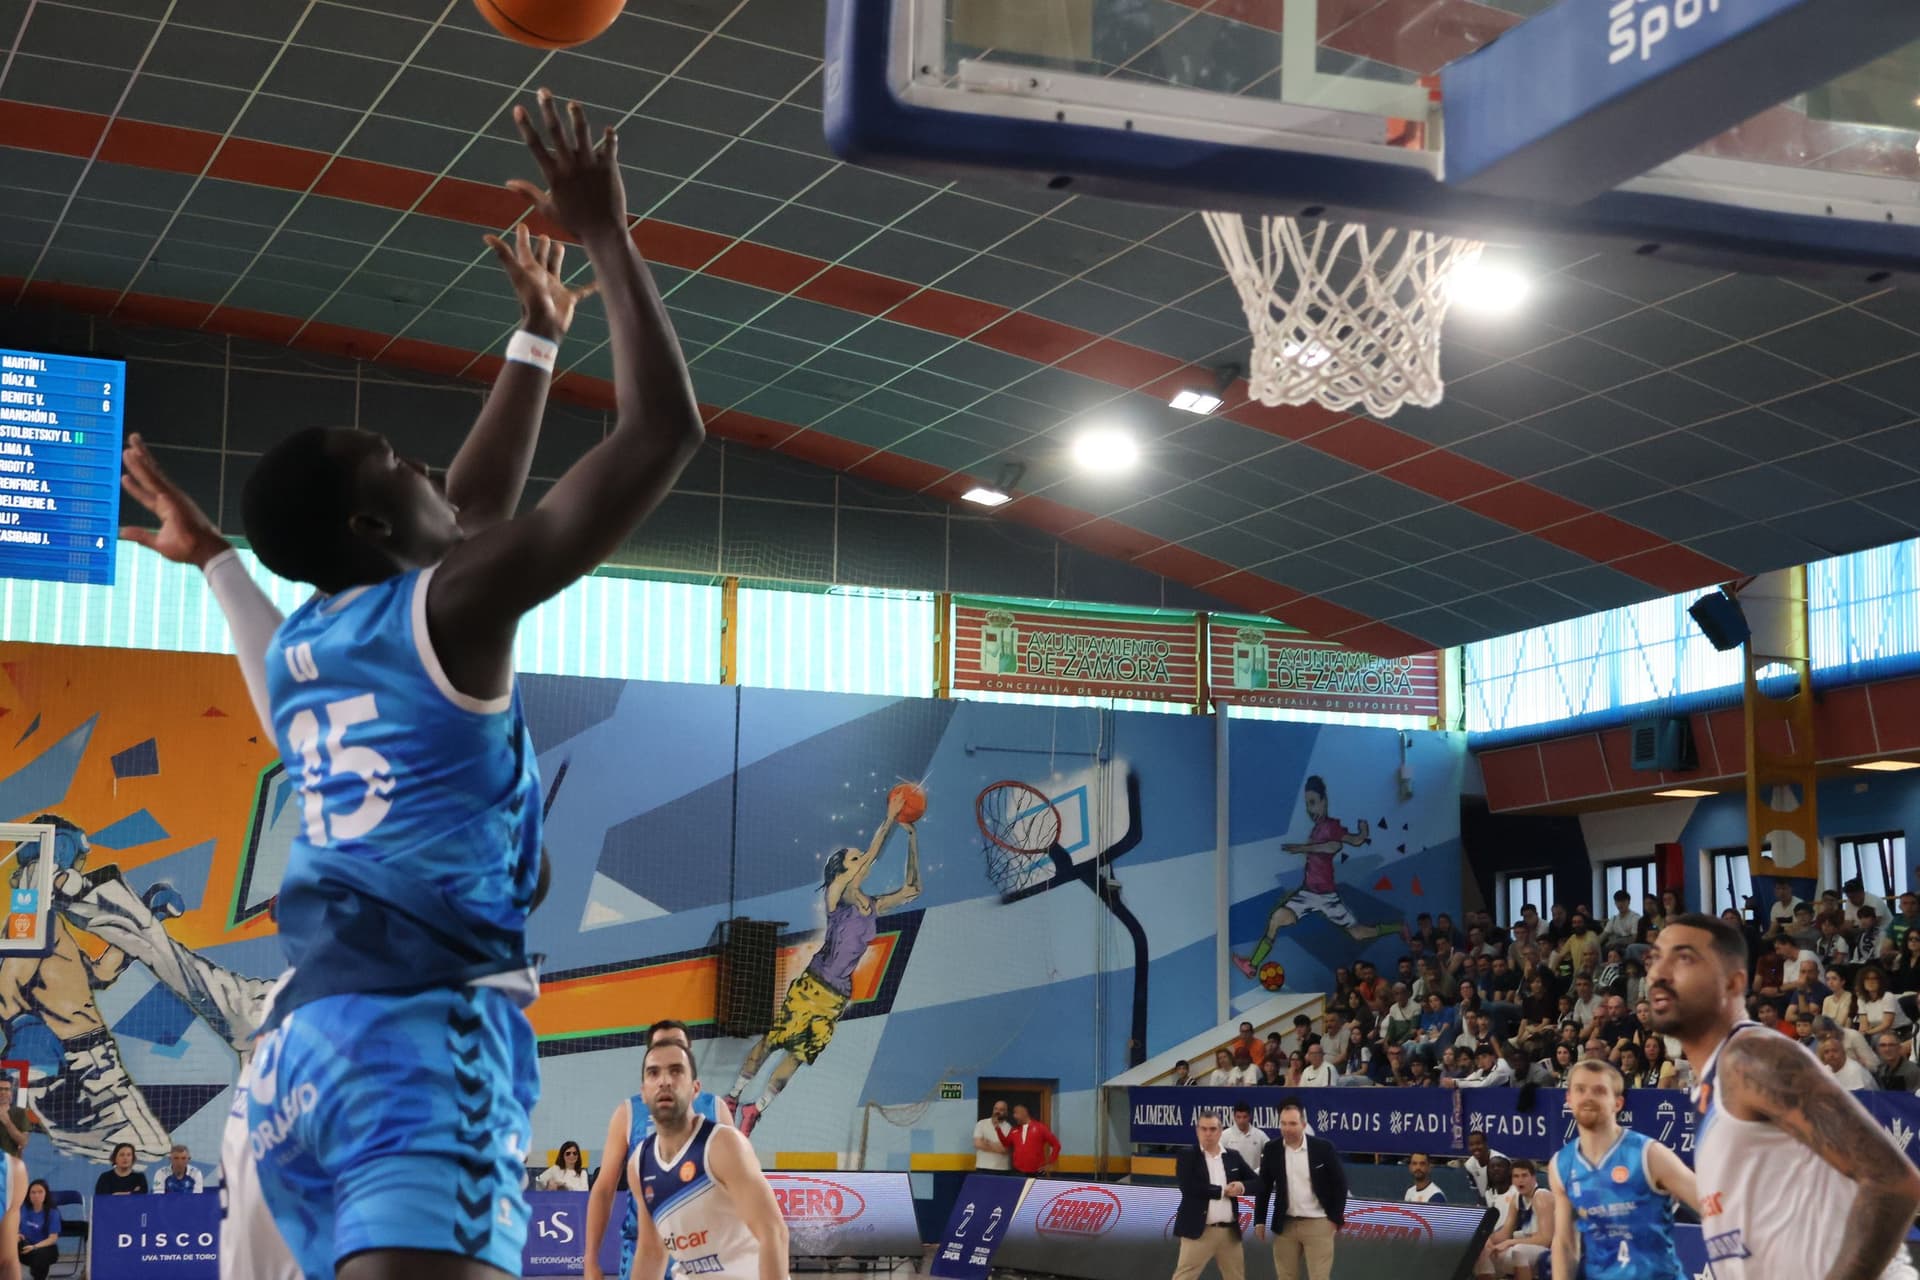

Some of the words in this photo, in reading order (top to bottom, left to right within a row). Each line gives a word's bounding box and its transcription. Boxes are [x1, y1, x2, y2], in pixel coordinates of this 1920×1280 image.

[2, 371, 25, 387] DÍAZ
[103, 383, 111, 396] 2
[36, 393, 45, 406] V.
[102, 400, 110, 413] 6
[48, 412, 59, 425] D.
[23, 444, 34, 457] A.
[26, 462, 35, 474] P.
[40, 480, 51, 493] A.
[11, 513, 20, 525] P.
[95, 537, 104, 550] 4
[1027, 631, 1170, 658] AYUNTAMIENTO
[1026, 651, 1057, 676] DE
[1061, 653, 1170, 683] ZAMORA
[1276, 666, 1307, 690] DE
[1312, 668, 1414, 695] ZAMORA
[1077, 687, 1092, 696] DE
[1101, 689, 1165, 699] DEPORTES
[1325, 700, 1340, 708] DE
[1349, 702, 1409, 711] DEPORTES
[287, 693, 396, 847] 15
[1134, 1104, 1183, 1126] ALIMERKA
[1330, 1112, 1381, 1132] FADIS
[1485, 1114, 1546, 1136] FADIS
[1043, 1199, 1114, 1233] FERRERO
[118, 1232, 214, 1248] DISCO
[196, 1253, 217, 1261] TORO
[1617, 1240, 1631, 1268] 4
